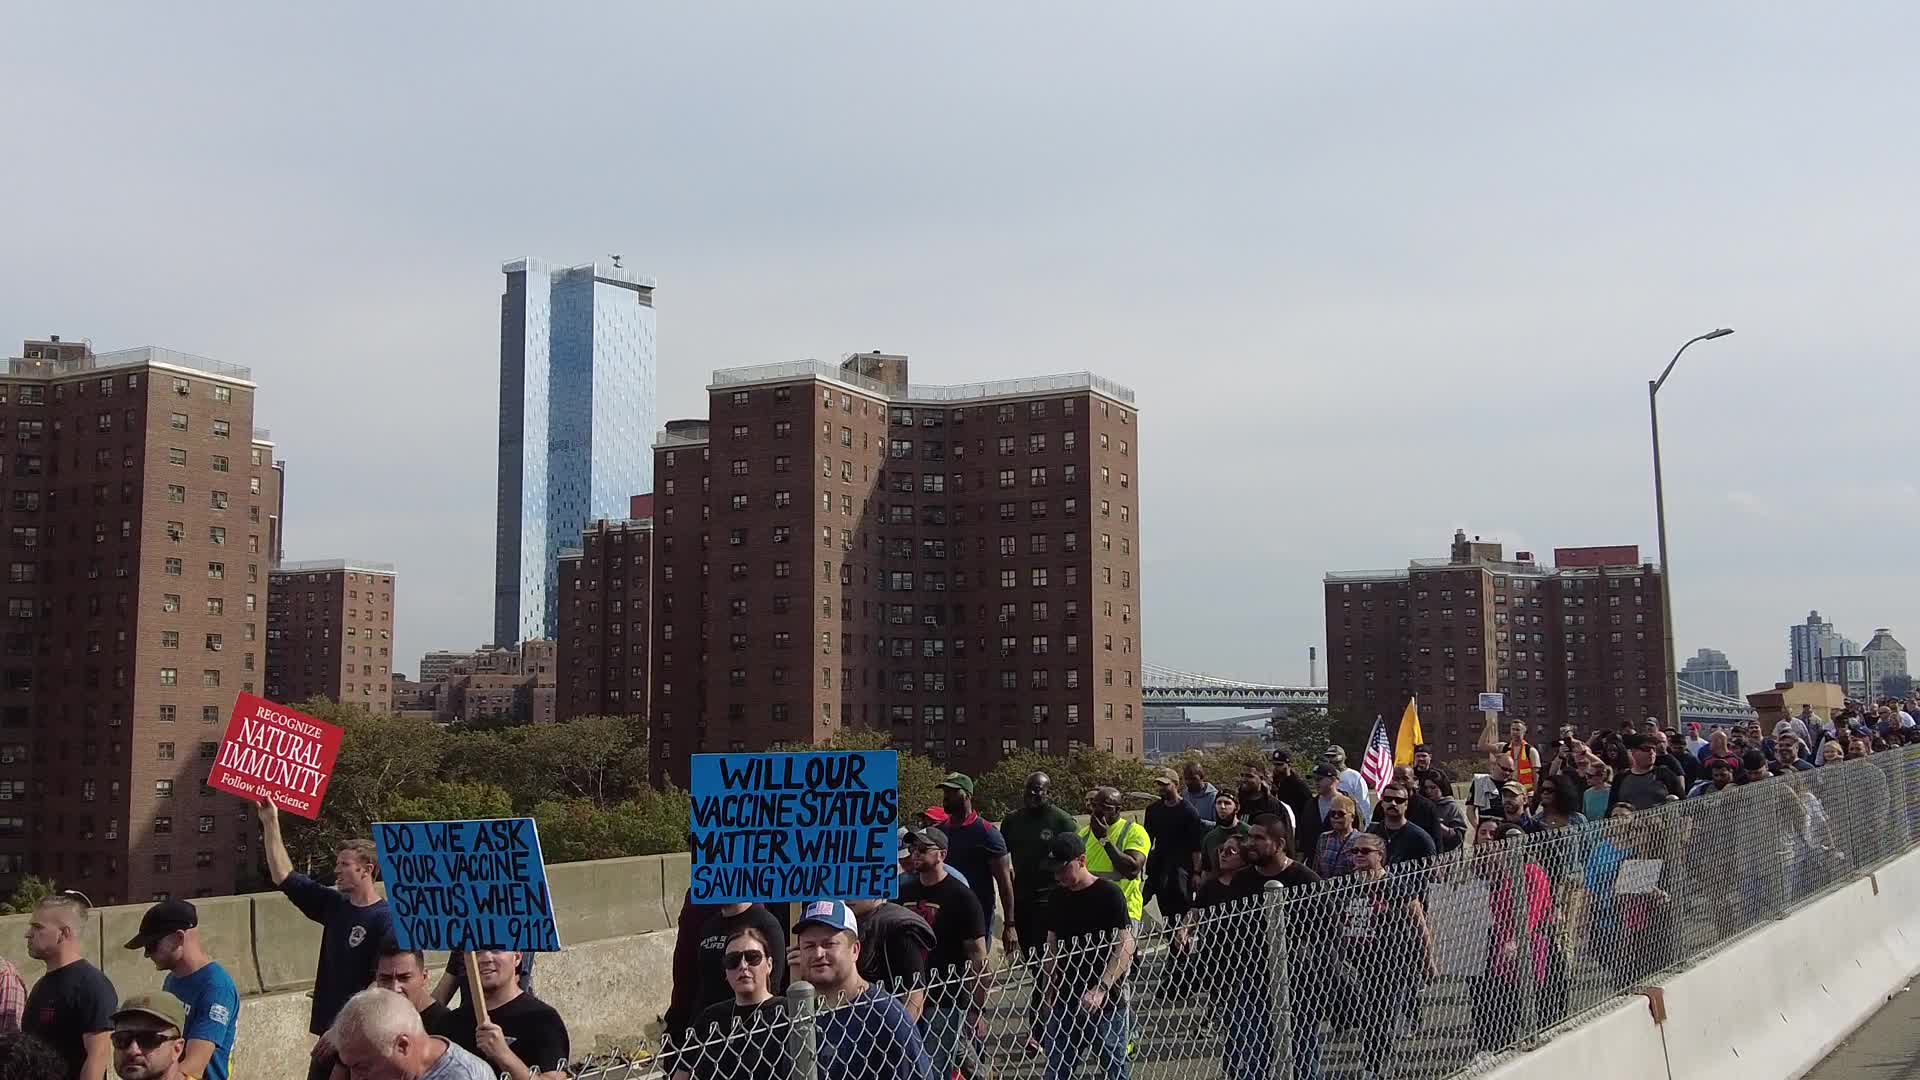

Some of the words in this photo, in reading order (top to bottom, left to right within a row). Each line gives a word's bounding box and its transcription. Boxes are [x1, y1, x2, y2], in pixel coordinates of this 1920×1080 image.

[256, 706, 323, 739] RECOGNIZE
[237, 717, 323, 769] NATURAL
[219, 741, 327, 797] IMMUNITY
[720, 756, 804, 790] WILL
[805, 754, 868, 790] OUR
[221, 773, 255, 792] Follow
[255, 785, 272, 798] the
[273, 790, 309, 811] Science
[691, 793, 798, 828] VACCINE
[796, 788, 898, 827] STATUS
[382, 824, 414, 853] DO
[424, 823, 465, 853] WE
[473, 820, 529, 852] ASK
[691, 828, 791, 864] MATTER
[796, 827, 889, 864] WHILE
[387, 853, 441, 883] YOUR
[443, 851, 530, 882] VACCINE
[693, 865, 776, 899] SAVING
[775, 864, 831, 897] YOUR
[834, 864, 898, 898] LIFE?
[392, 882, 469, 918] STATUS
[471, 881, 548, 916] WHEN
[399, 917, 441, 950] YOU
[447, 918, 506, 950] CALL
[508, 918, 555, 951] 911?
